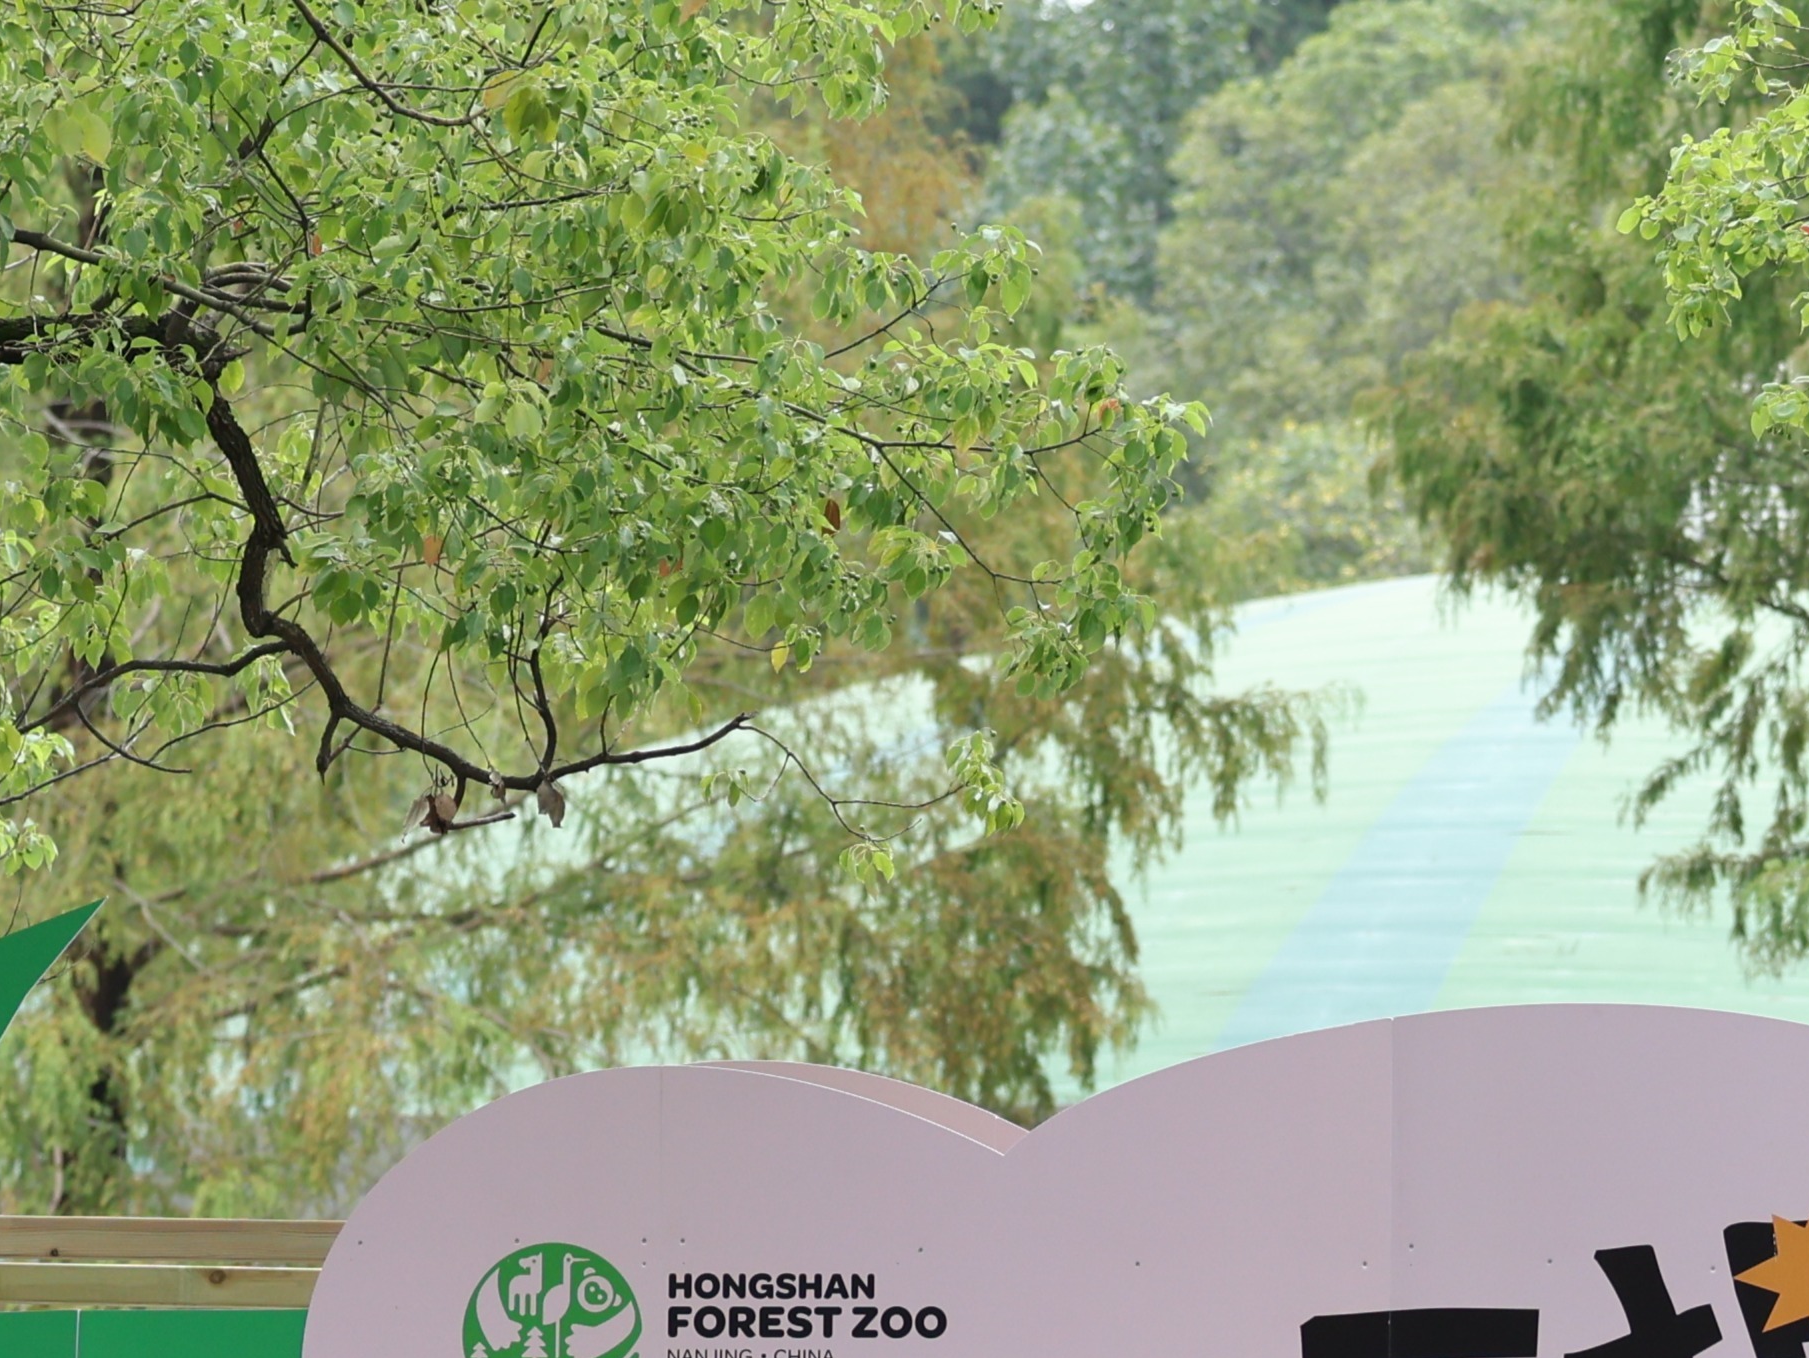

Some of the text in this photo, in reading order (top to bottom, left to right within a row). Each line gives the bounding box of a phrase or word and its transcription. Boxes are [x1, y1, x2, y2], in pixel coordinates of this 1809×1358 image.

[667, 1272, 876, 1300] HONGSHAN
[667, 1305, 948, 1339] FOREST ZOO
